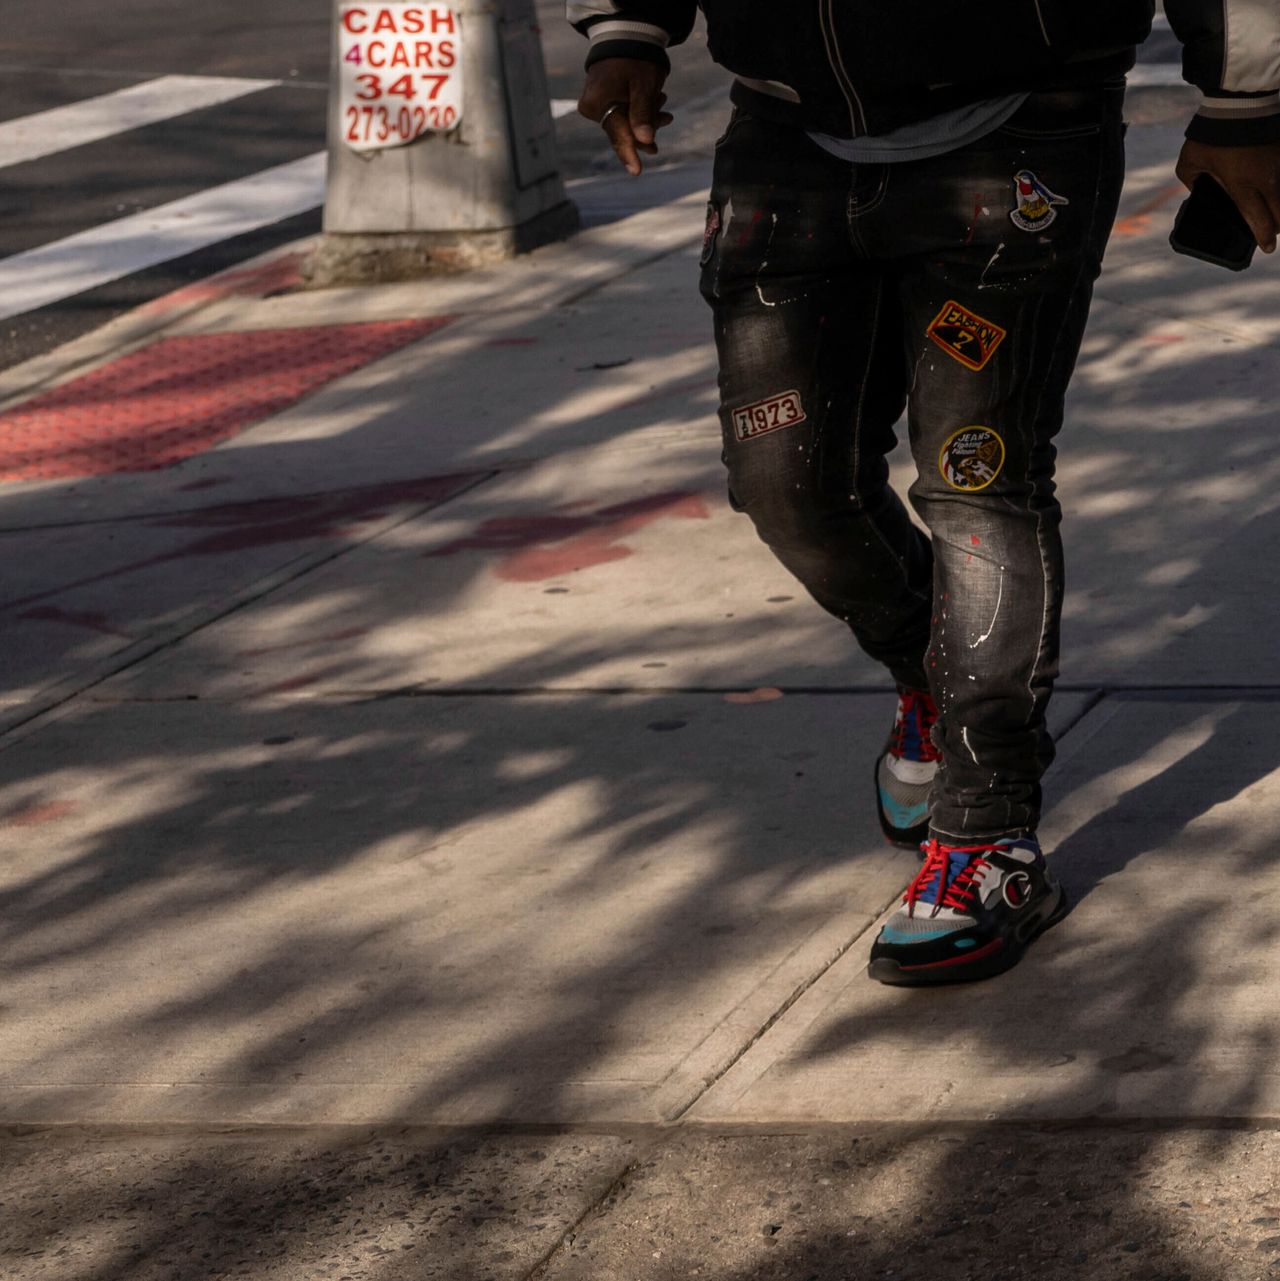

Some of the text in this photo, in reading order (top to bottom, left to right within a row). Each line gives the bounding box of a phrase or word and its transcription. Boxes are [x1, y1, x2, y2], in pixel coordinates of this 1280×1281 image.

[343, 8, 455, 34] CASH
[355, 74, 450, 101] 347
[747, 398, 798, 433] 1973
[959, 432, 991, 442] JEANS
